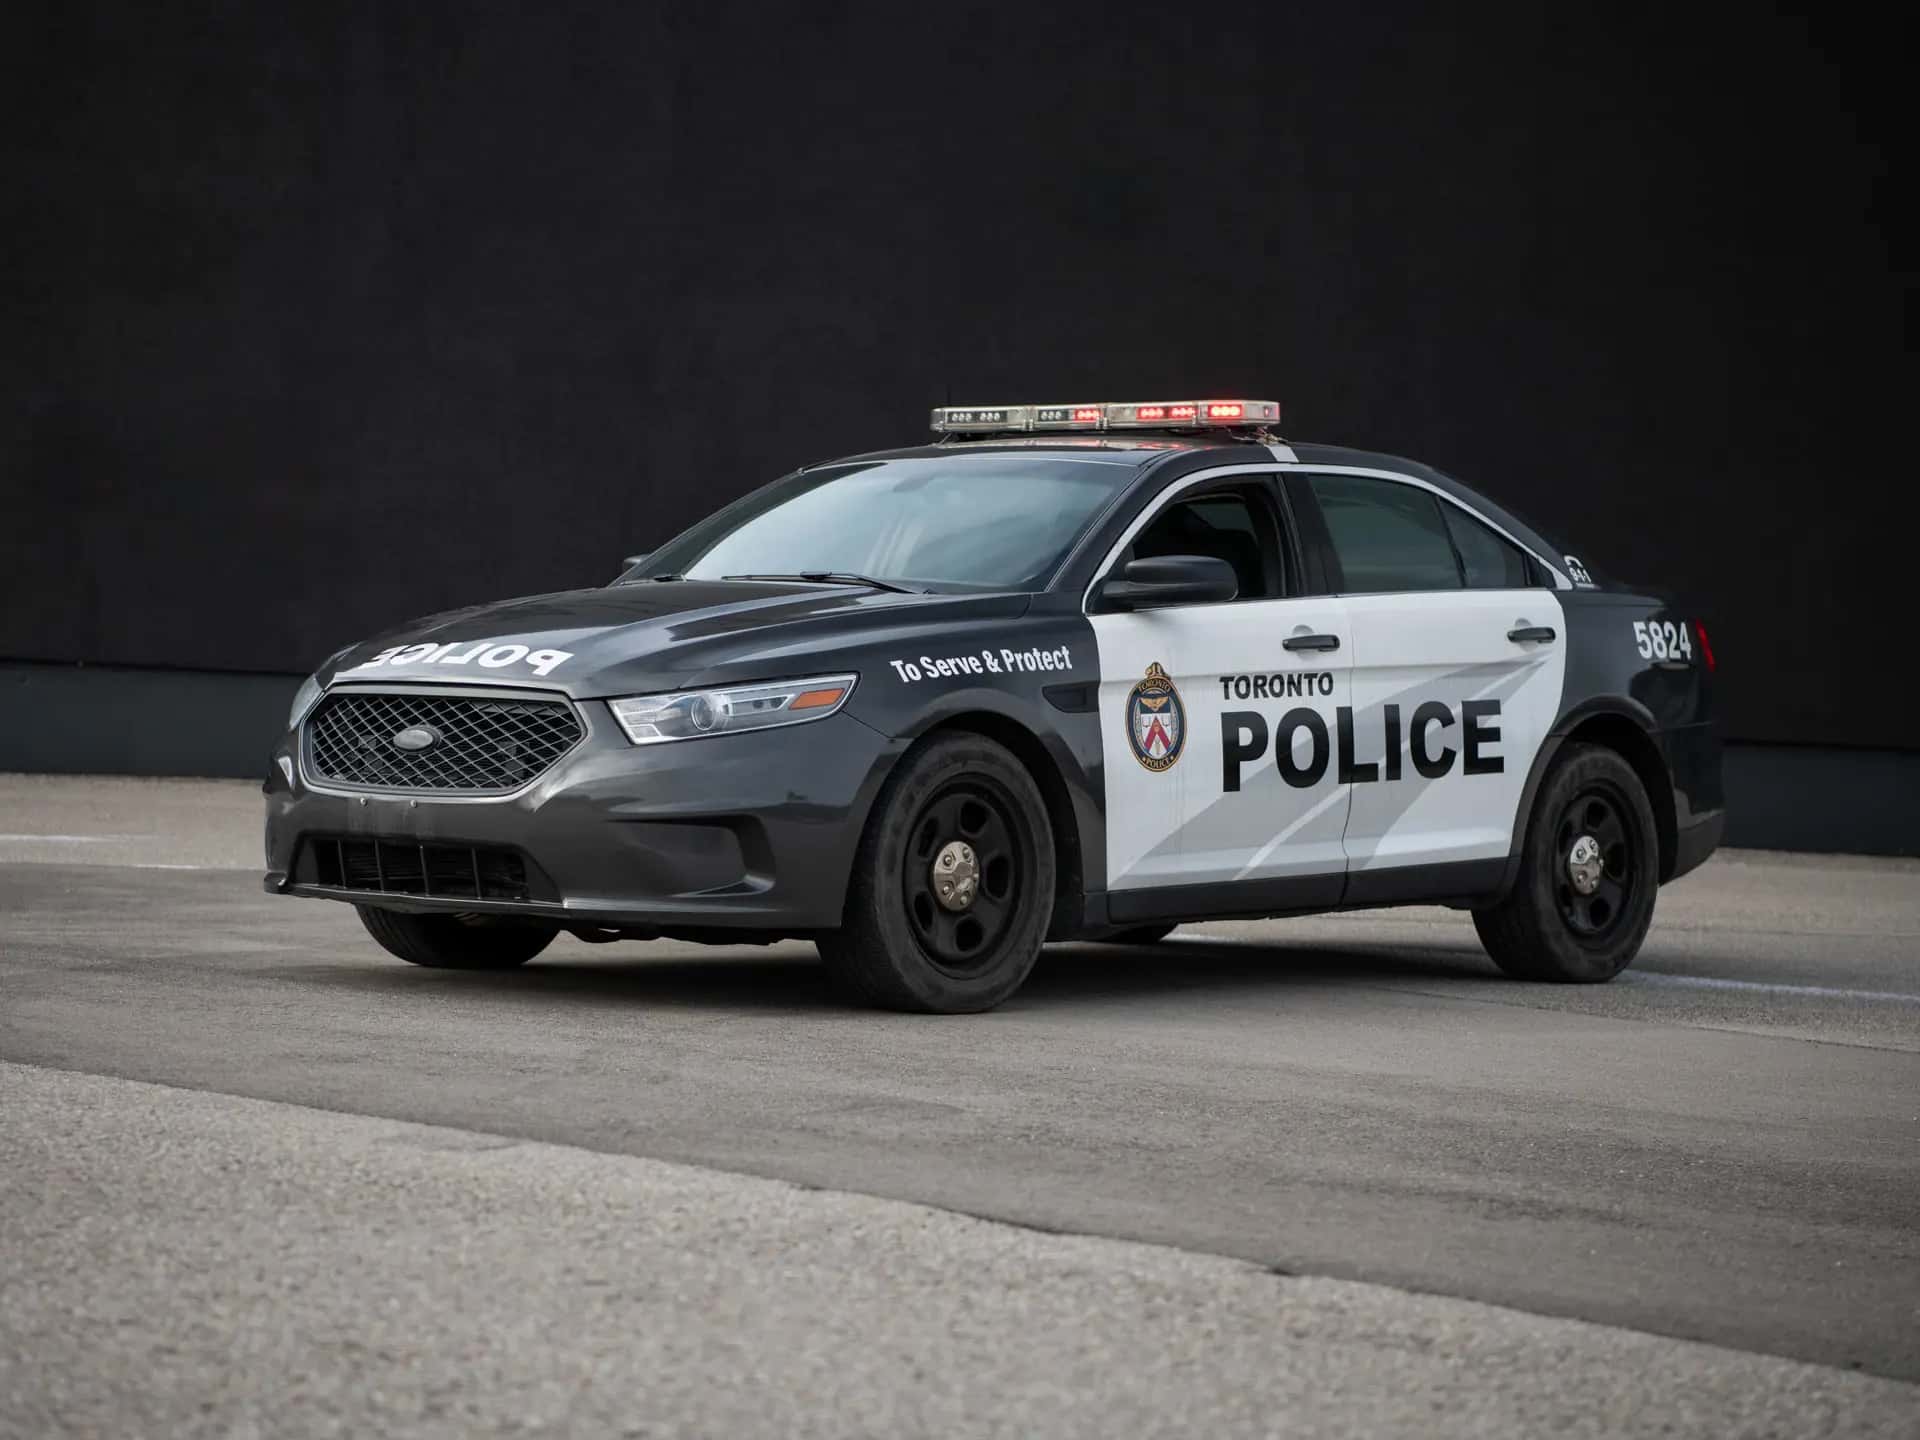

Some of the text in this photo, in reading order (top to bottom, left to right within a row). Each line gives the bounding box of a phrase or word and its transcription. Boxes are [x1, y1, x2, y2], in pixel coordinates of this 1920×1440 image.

[1633, 621, 1692, 660] 5824
[890, 645, 1073, 683] To Serve & Protect
[1220, 672, 1334, 700] TORONTO
[1220, 699, 1505, 793] POLICE
